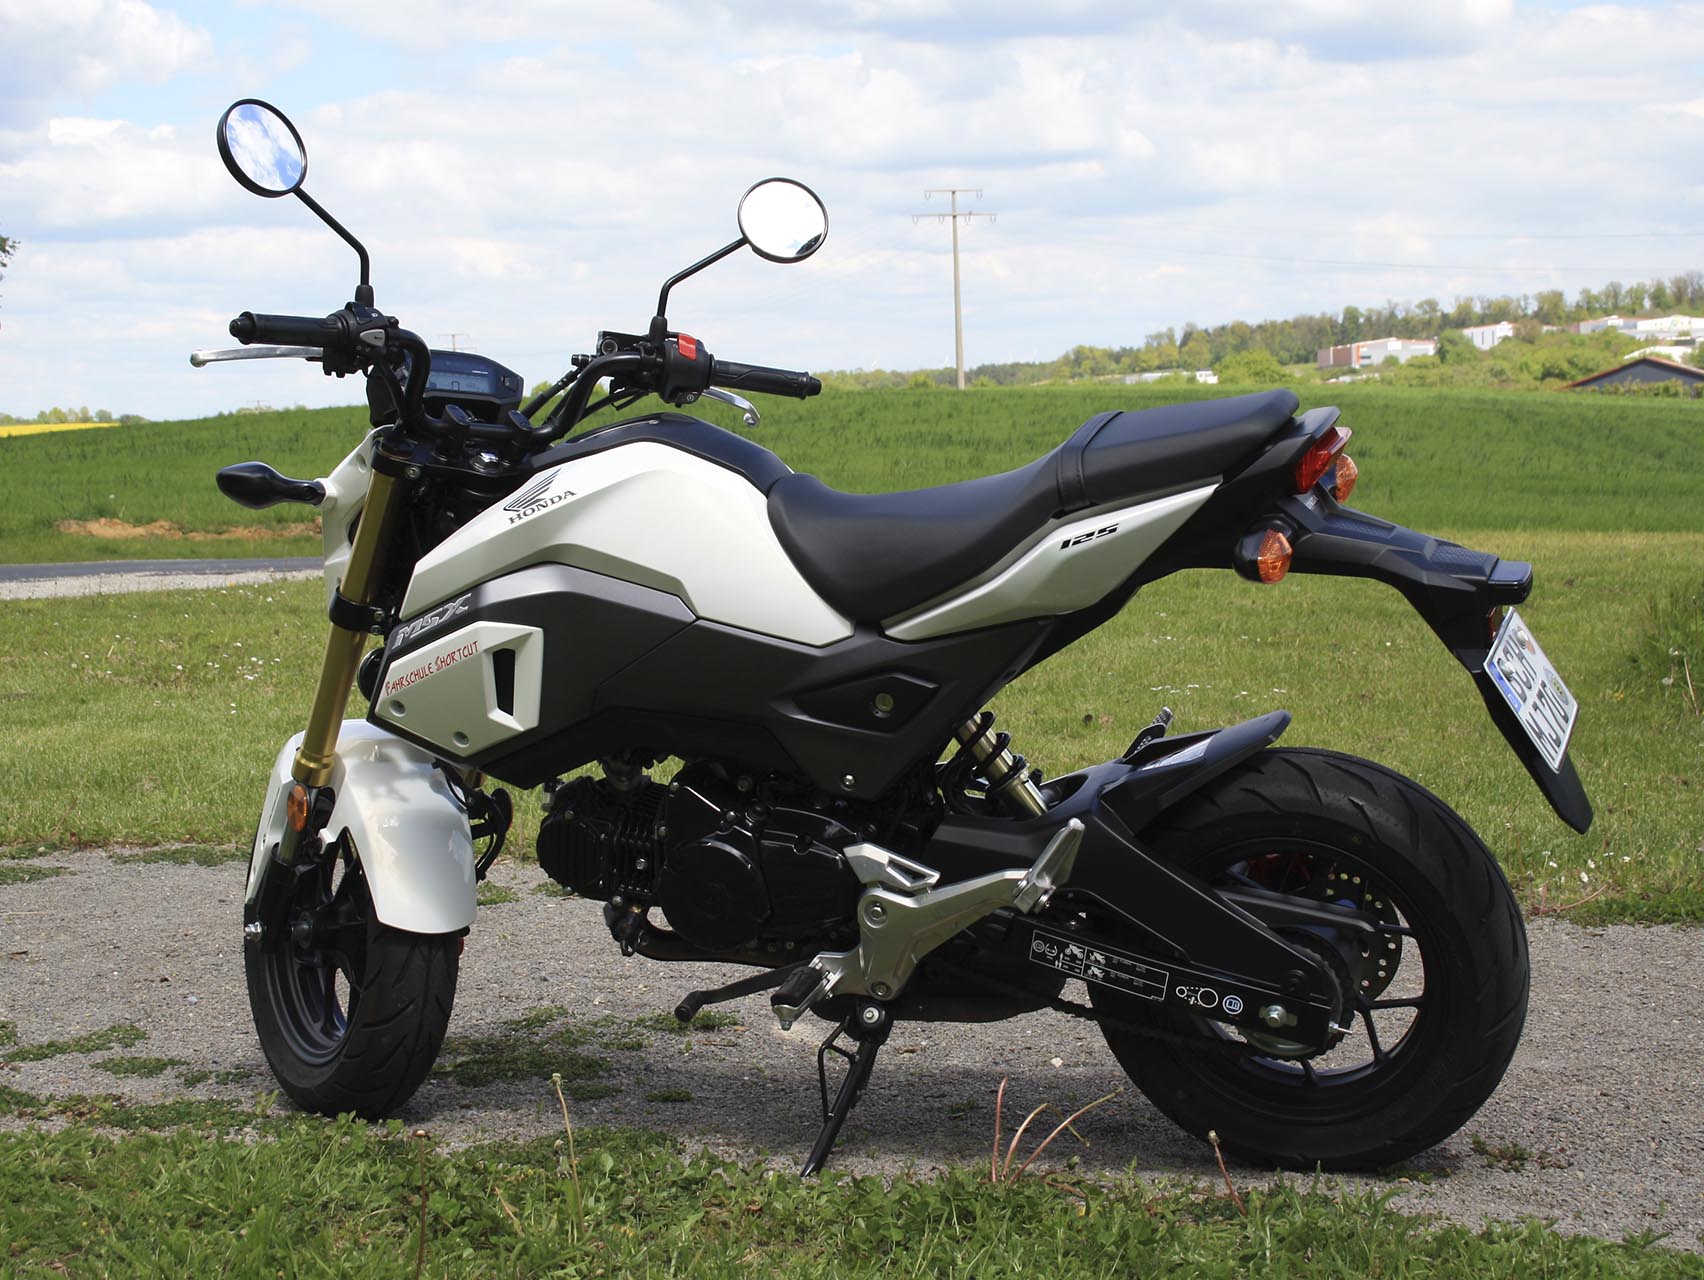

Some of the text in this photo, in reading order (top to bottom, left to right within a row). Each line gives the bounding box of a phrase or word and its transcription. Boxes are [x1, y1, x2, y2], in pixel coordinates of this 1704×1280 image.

[508, 490, 576, 524] HONDA
[1060, 523, 1119, 549] 125
[385, 641, 479, 696] FAHRSCHULE SHORTCUT
